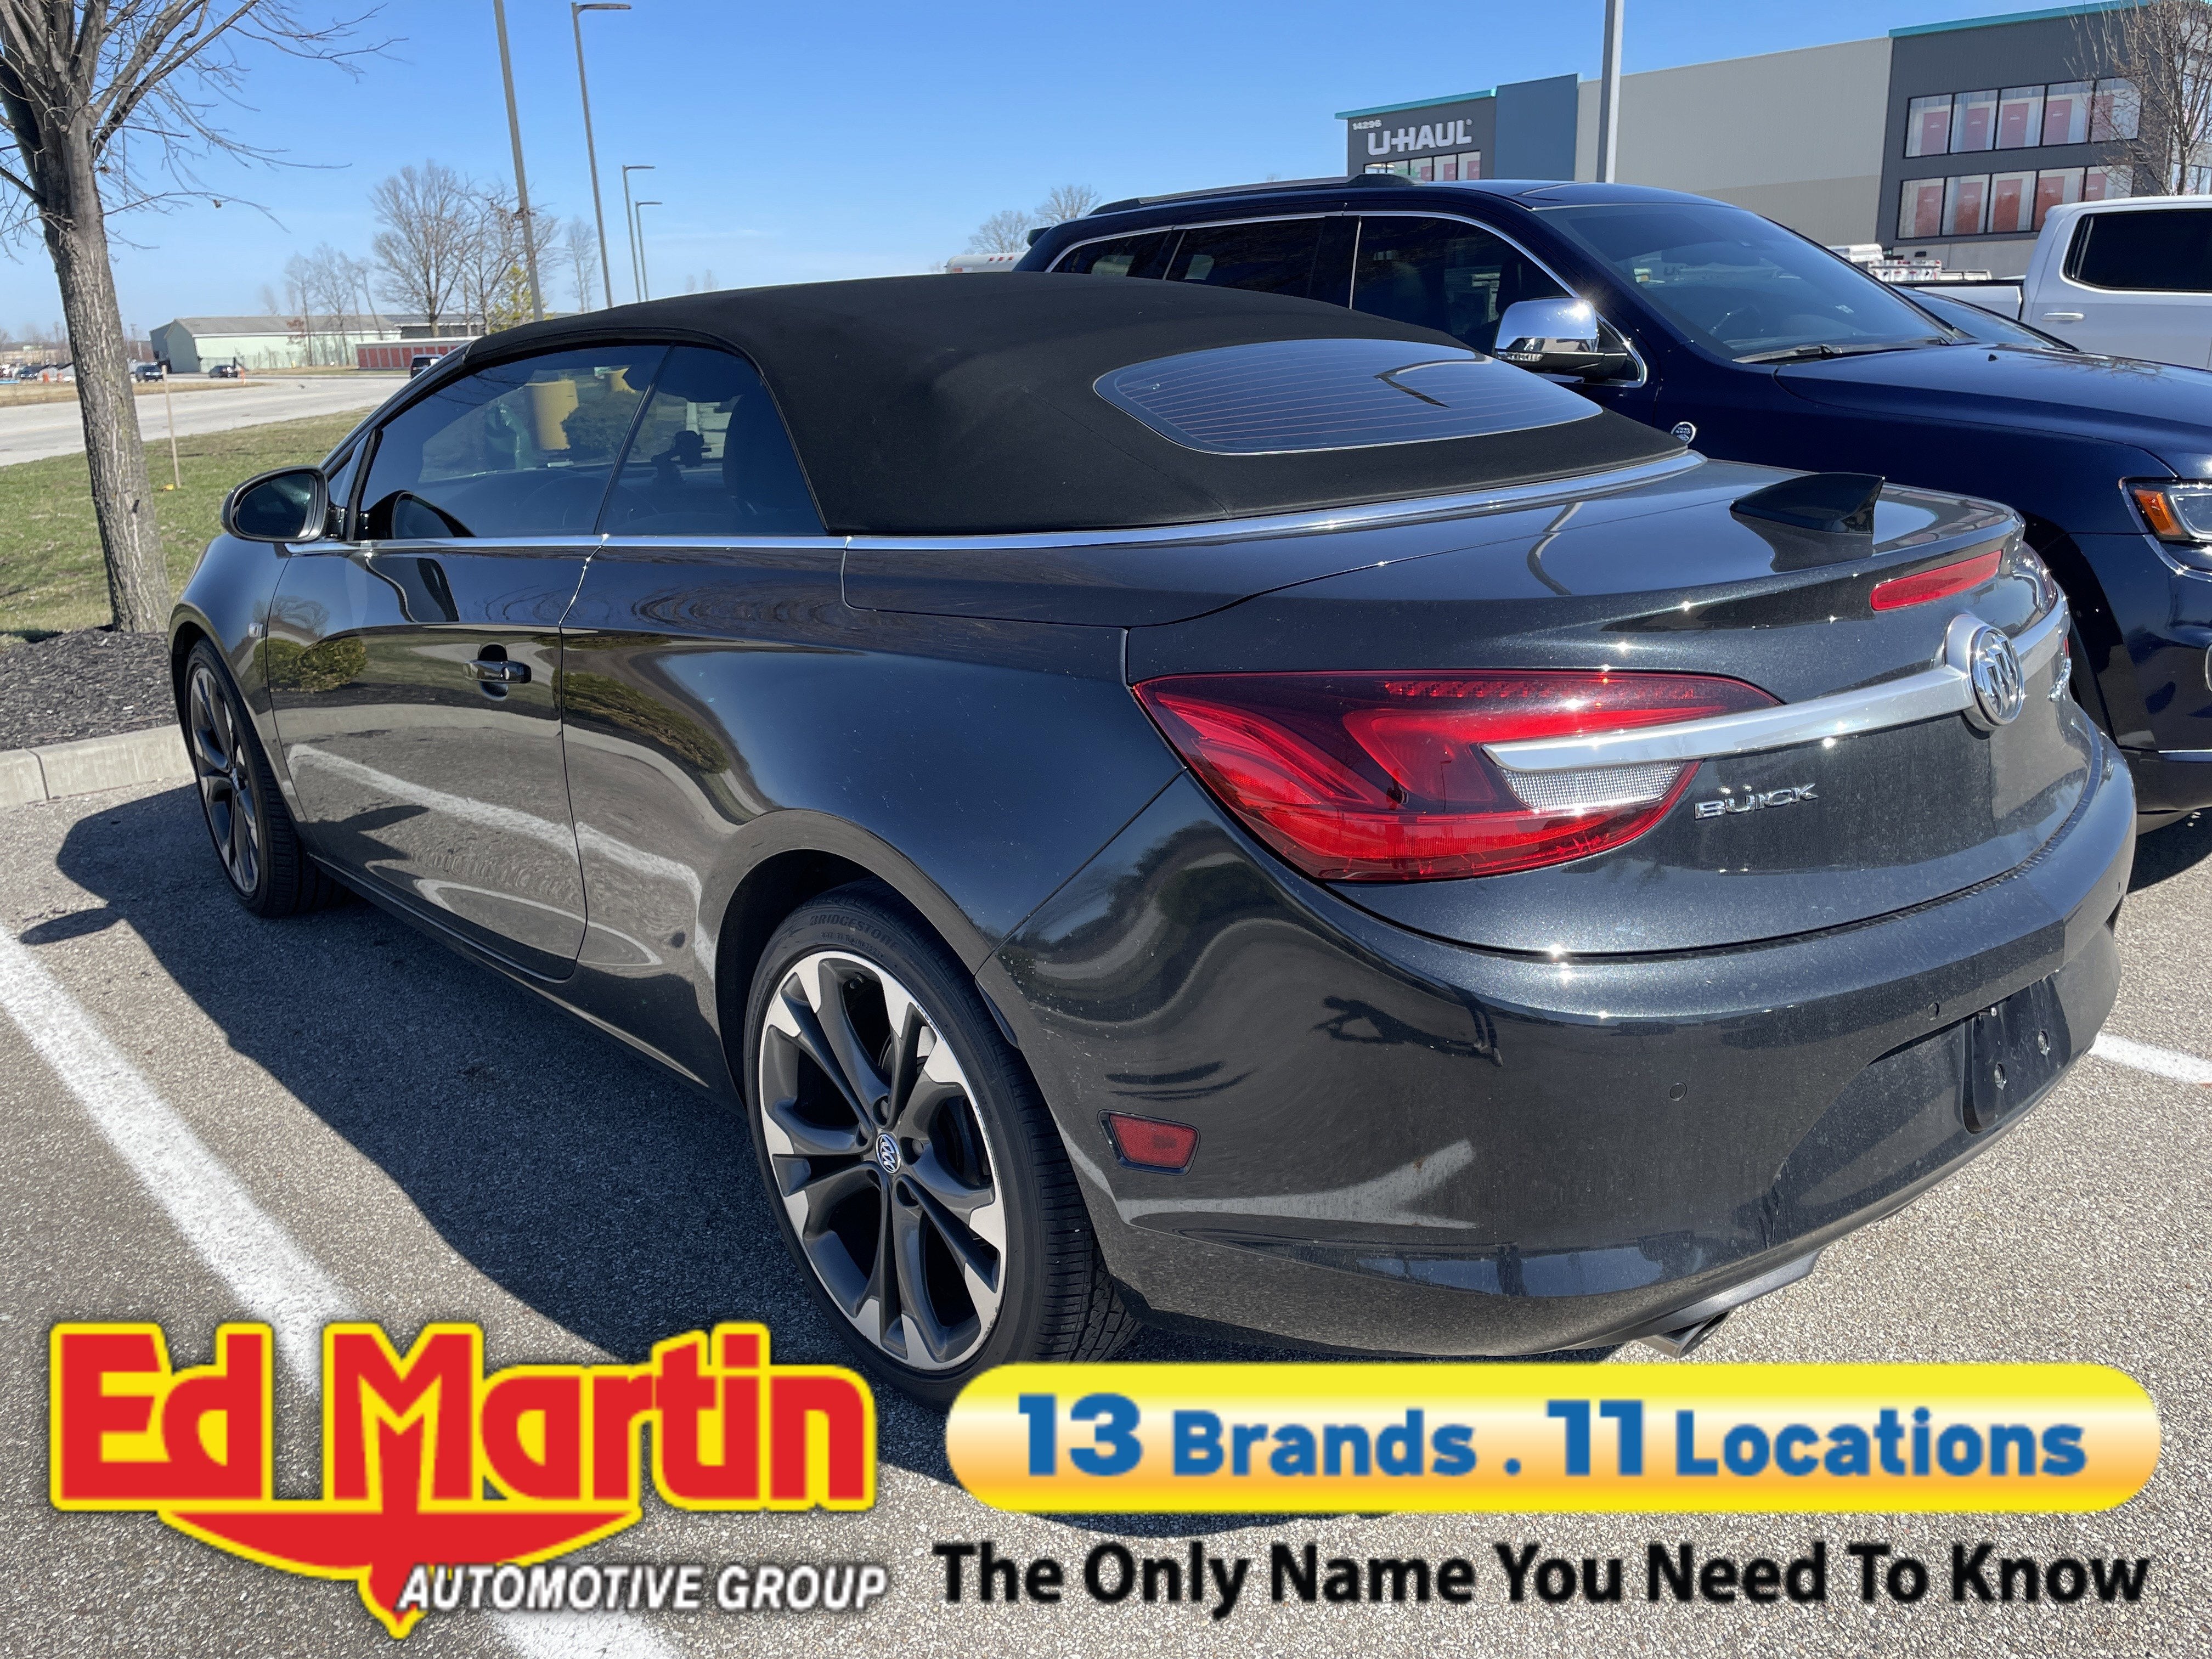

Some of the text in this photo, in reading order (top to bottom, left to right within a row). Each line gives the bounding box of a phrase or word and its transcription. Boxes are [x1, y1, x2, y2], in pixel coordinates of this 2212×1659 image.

[1367, 119, 1472, 156] U-HAUL
[1694, 782, 1819, 820] BUICK
[809, 913, 901, 952] BRIDGESTONE
